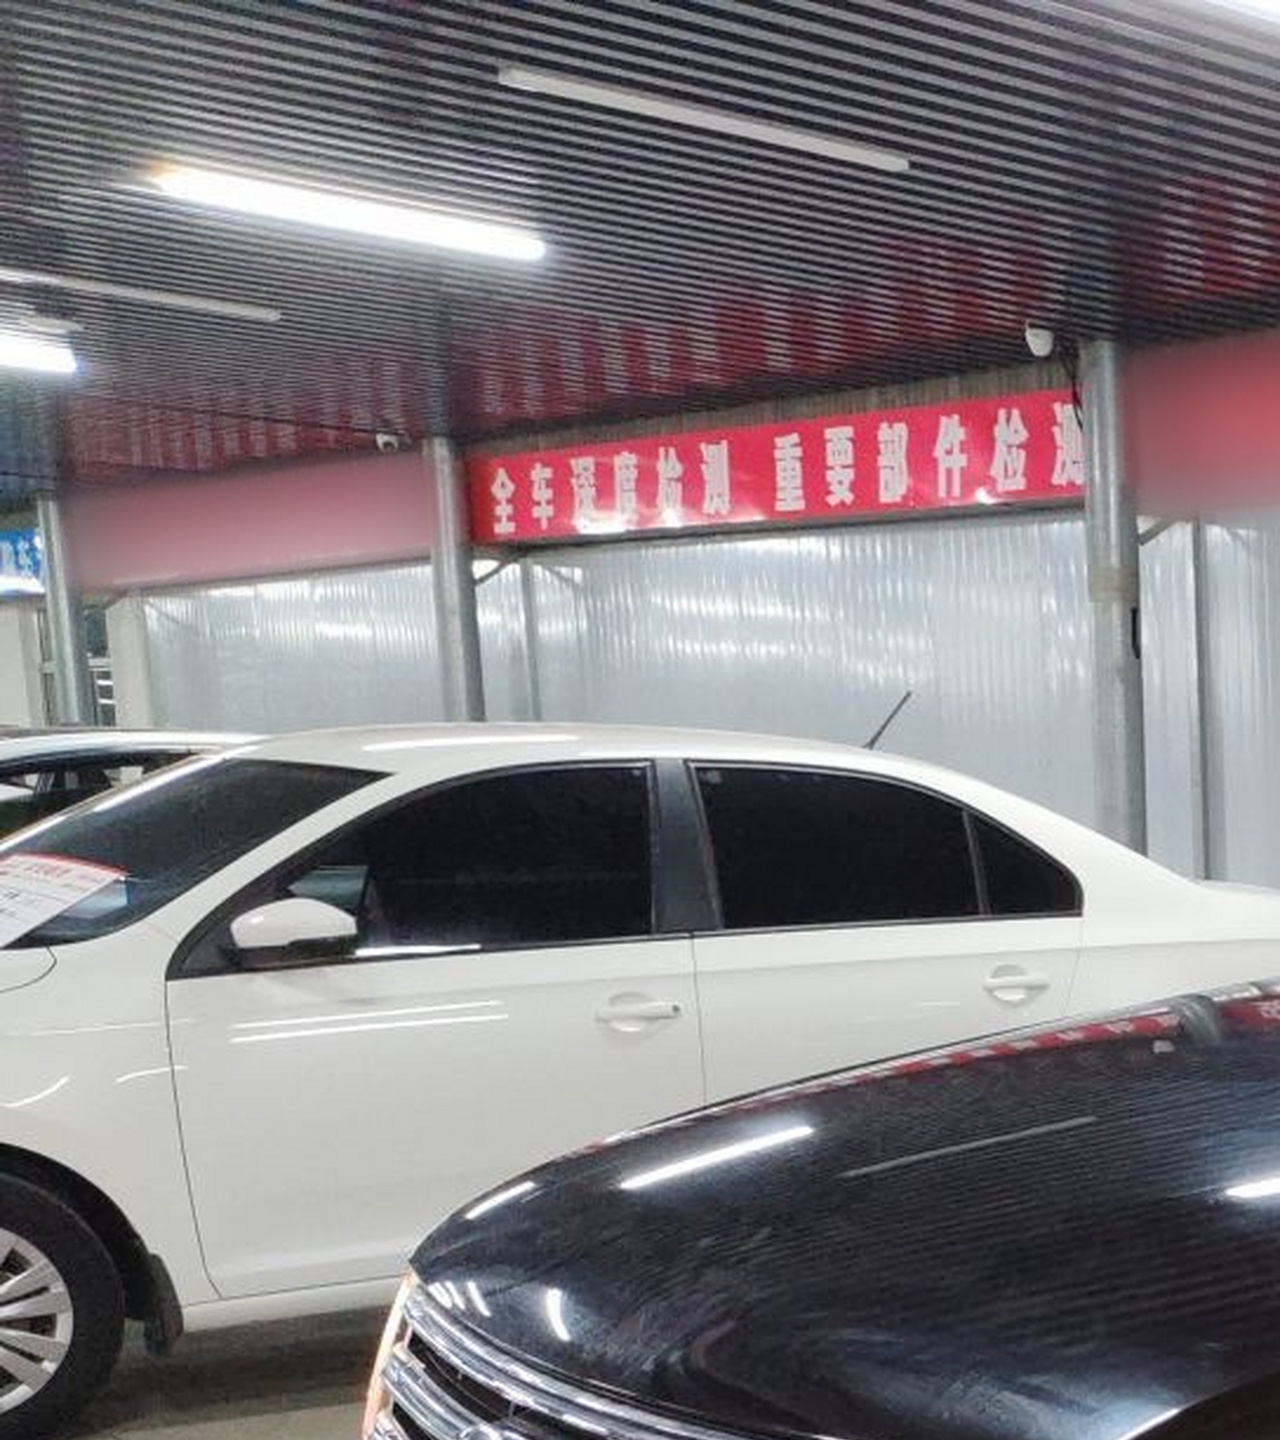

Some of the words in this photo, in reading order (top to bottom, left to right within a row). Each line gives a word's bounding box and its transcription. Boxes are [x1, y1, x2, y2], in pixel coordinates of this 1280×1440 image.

[490, 440, 732, 534] 全车深度检测
[773, 402, 1084, 512] 重要部件检测
